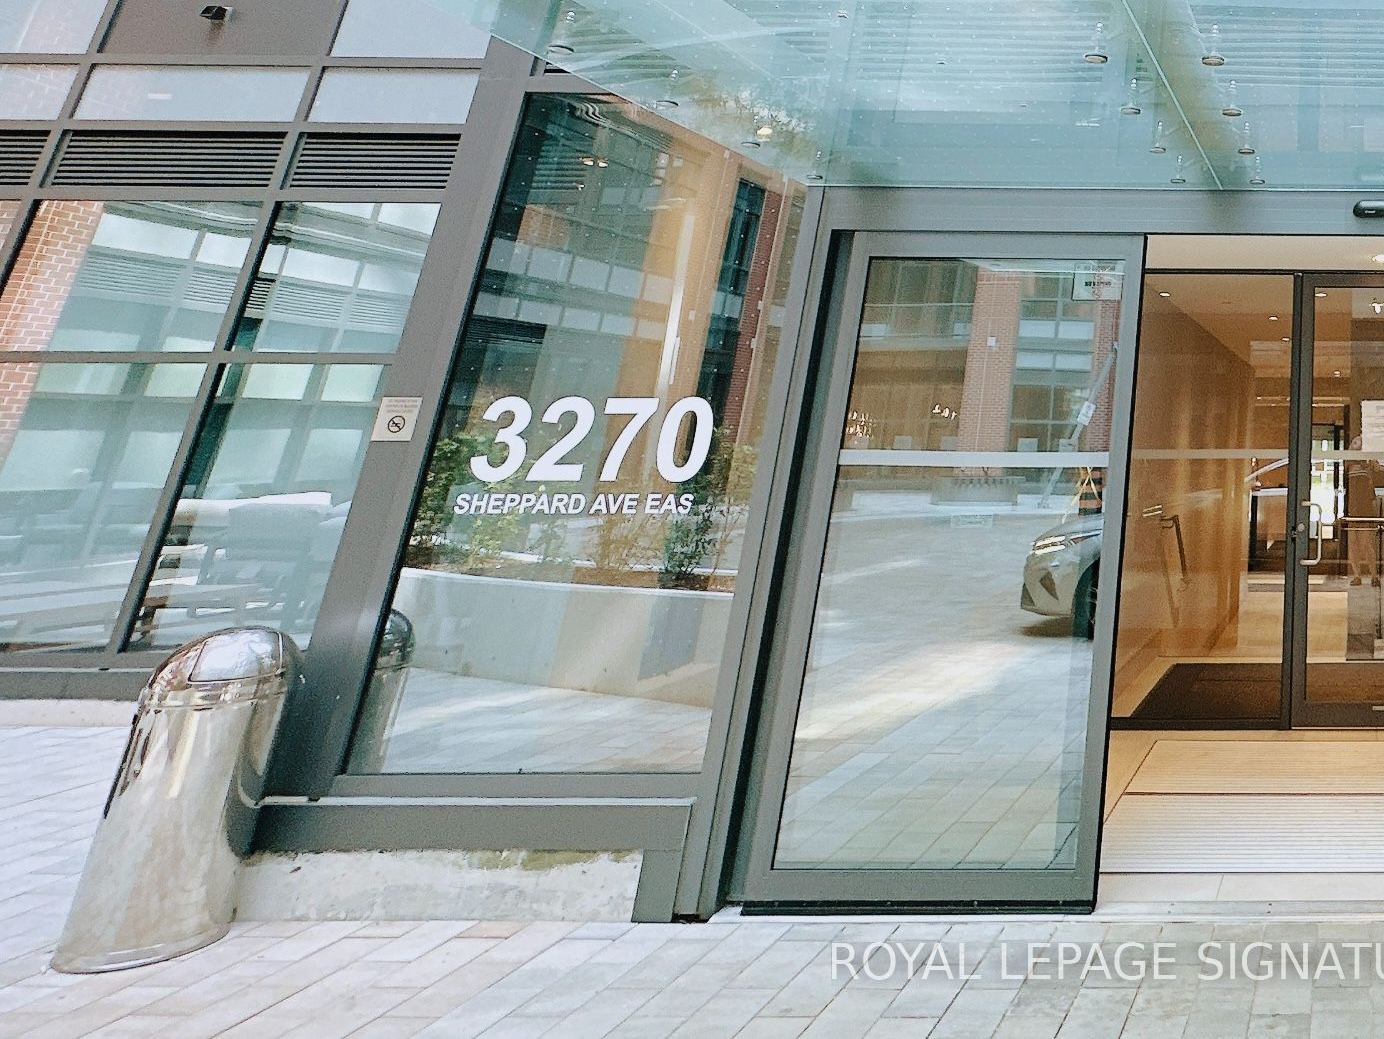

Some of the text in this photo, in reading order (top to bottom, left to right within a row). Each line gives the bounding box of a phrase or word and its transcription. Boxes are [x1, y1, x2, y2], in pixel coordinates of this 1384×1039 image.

[470, 395, 714, 483] 3270
[453, 493, 695, 515] SHEPPARD AVE EAS
